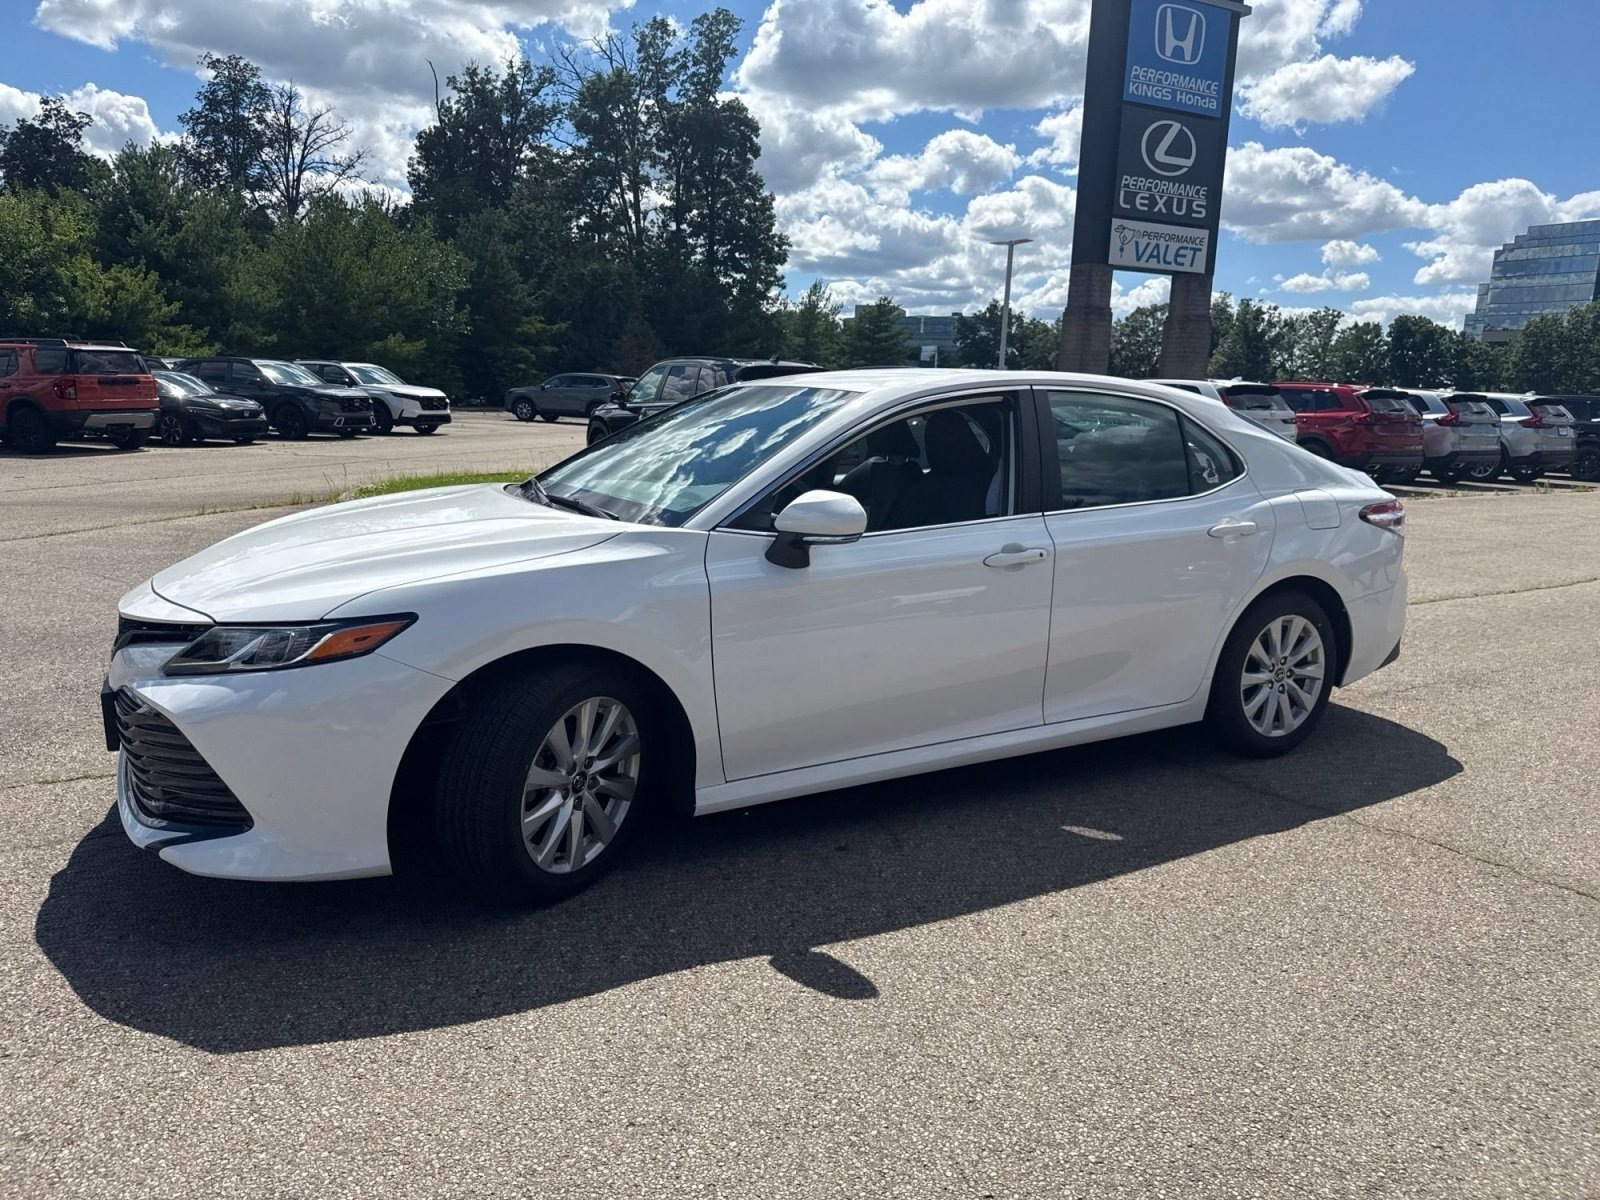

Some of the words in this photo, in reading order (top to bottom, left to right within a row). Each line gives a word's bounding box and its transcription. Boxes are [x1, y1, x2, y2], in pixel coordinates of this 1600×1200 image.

[1130, 65, 1219, 95] PERFORMANCE
[1129, 81, 1172, 101] KINGS
[1176, 90, 1217, 110] Honda
[1121, 175, 1208, 199] PERFORMANCE
[1119, 189, 1207, 218] LEXUS
[1141, 230, 1205, 247] PERFORMANCE
[1134, 240, 1202, 268] VALET
